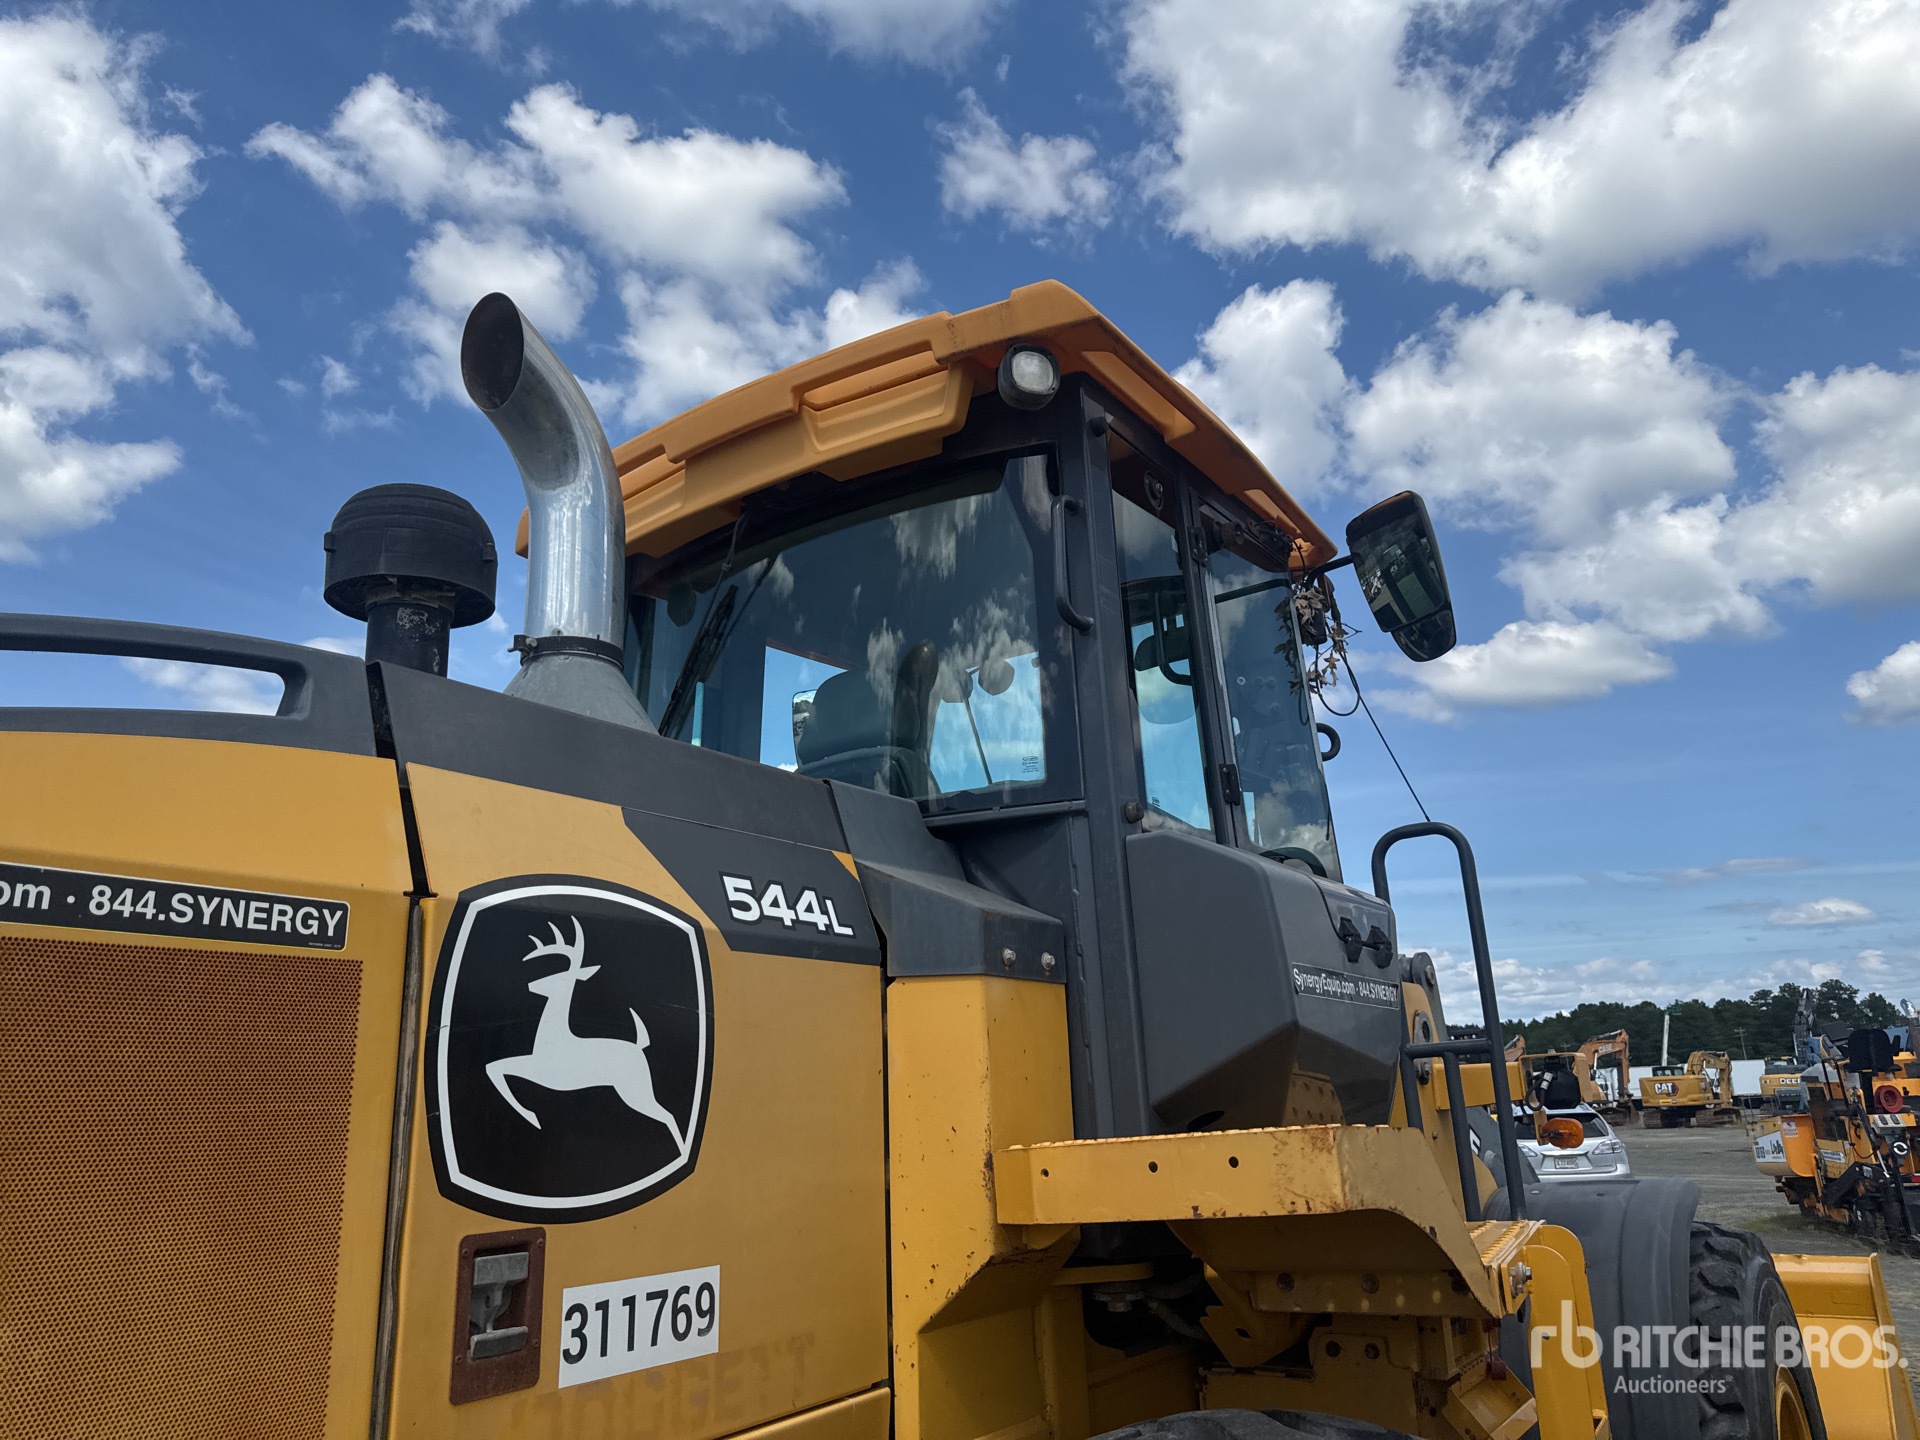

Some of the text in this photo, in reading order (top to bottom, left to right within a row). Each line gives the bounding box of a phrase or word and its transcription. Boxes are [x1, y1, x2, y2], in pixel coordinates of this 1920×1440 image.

[88, 883, 343, 937] 844.SYNERGY
[722, 875, 854, 936] 544L
[1293, 968, 1356, 996] SynergyEquip.com
[1654, 1082, 1673, 1095] CAT
[561, 1281, 717, 1366] 311769
